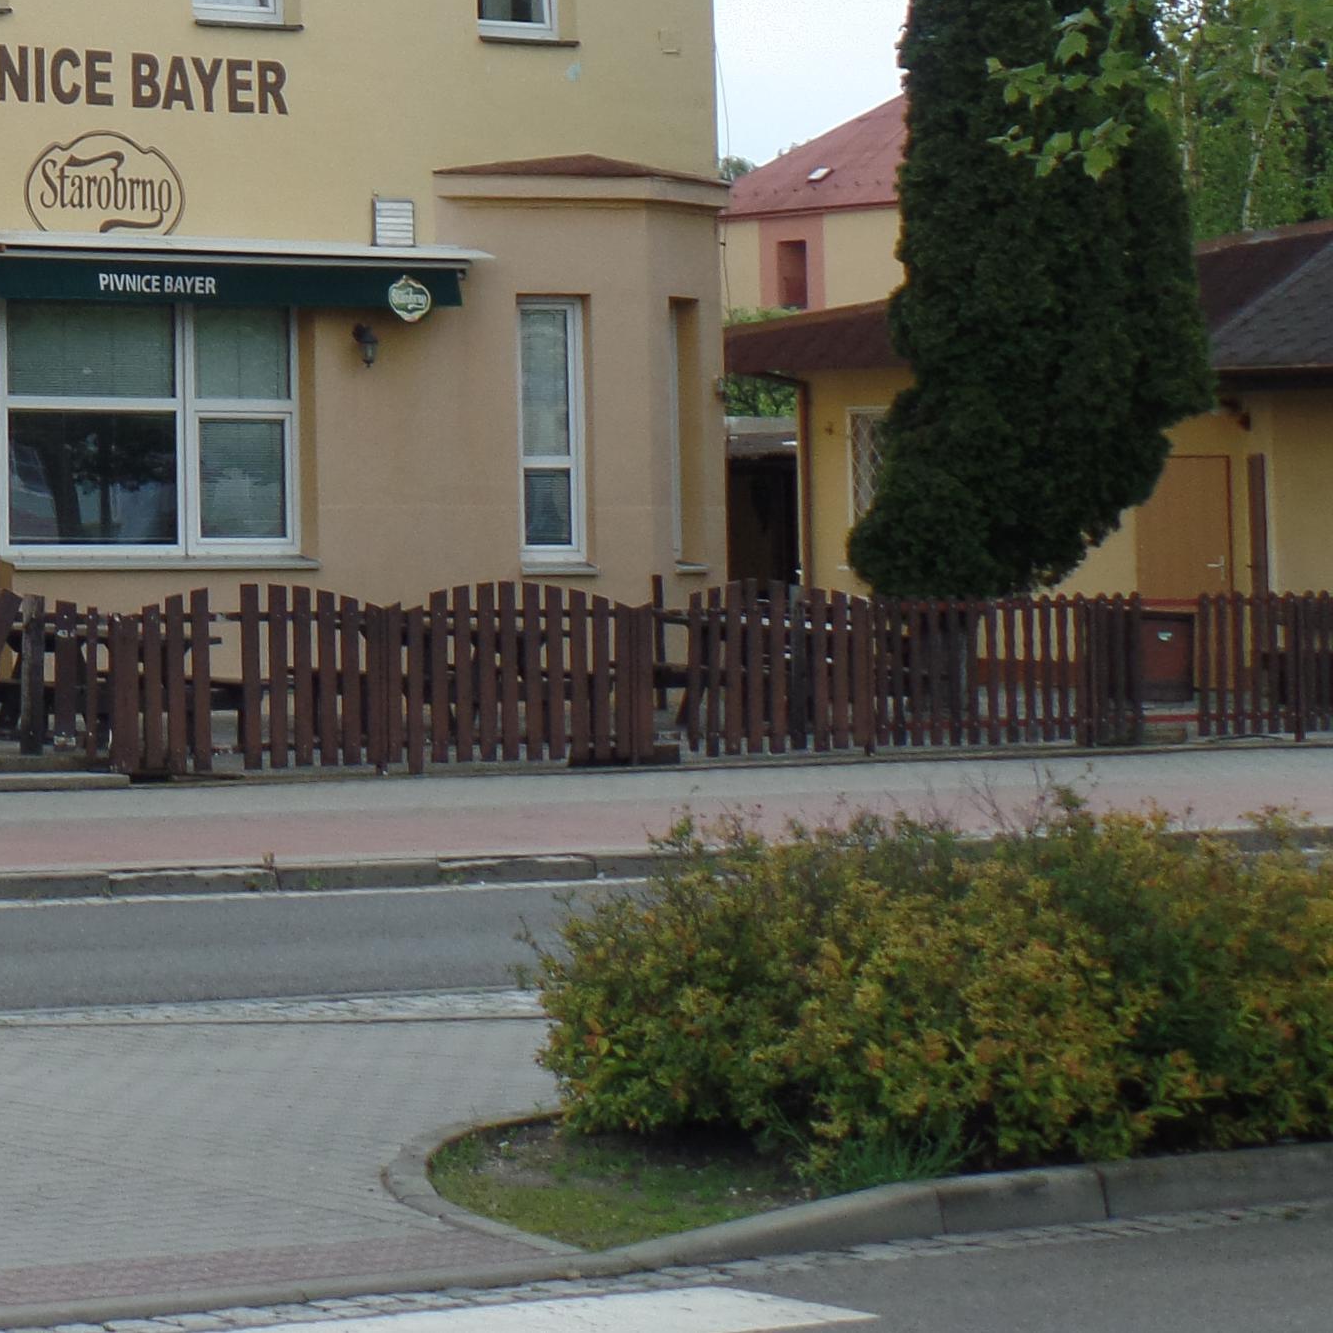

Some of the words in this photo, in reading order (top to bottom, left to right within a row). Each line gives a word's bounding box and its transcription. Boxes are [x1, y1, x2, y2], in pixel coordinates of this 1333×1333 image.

[131, 52, 289, 116] BAYER
[39, 150, 173, 233] Starobrno
[98, 273, 161, 293] PIVNICE
[164, 275, 217, 295] BAYER
